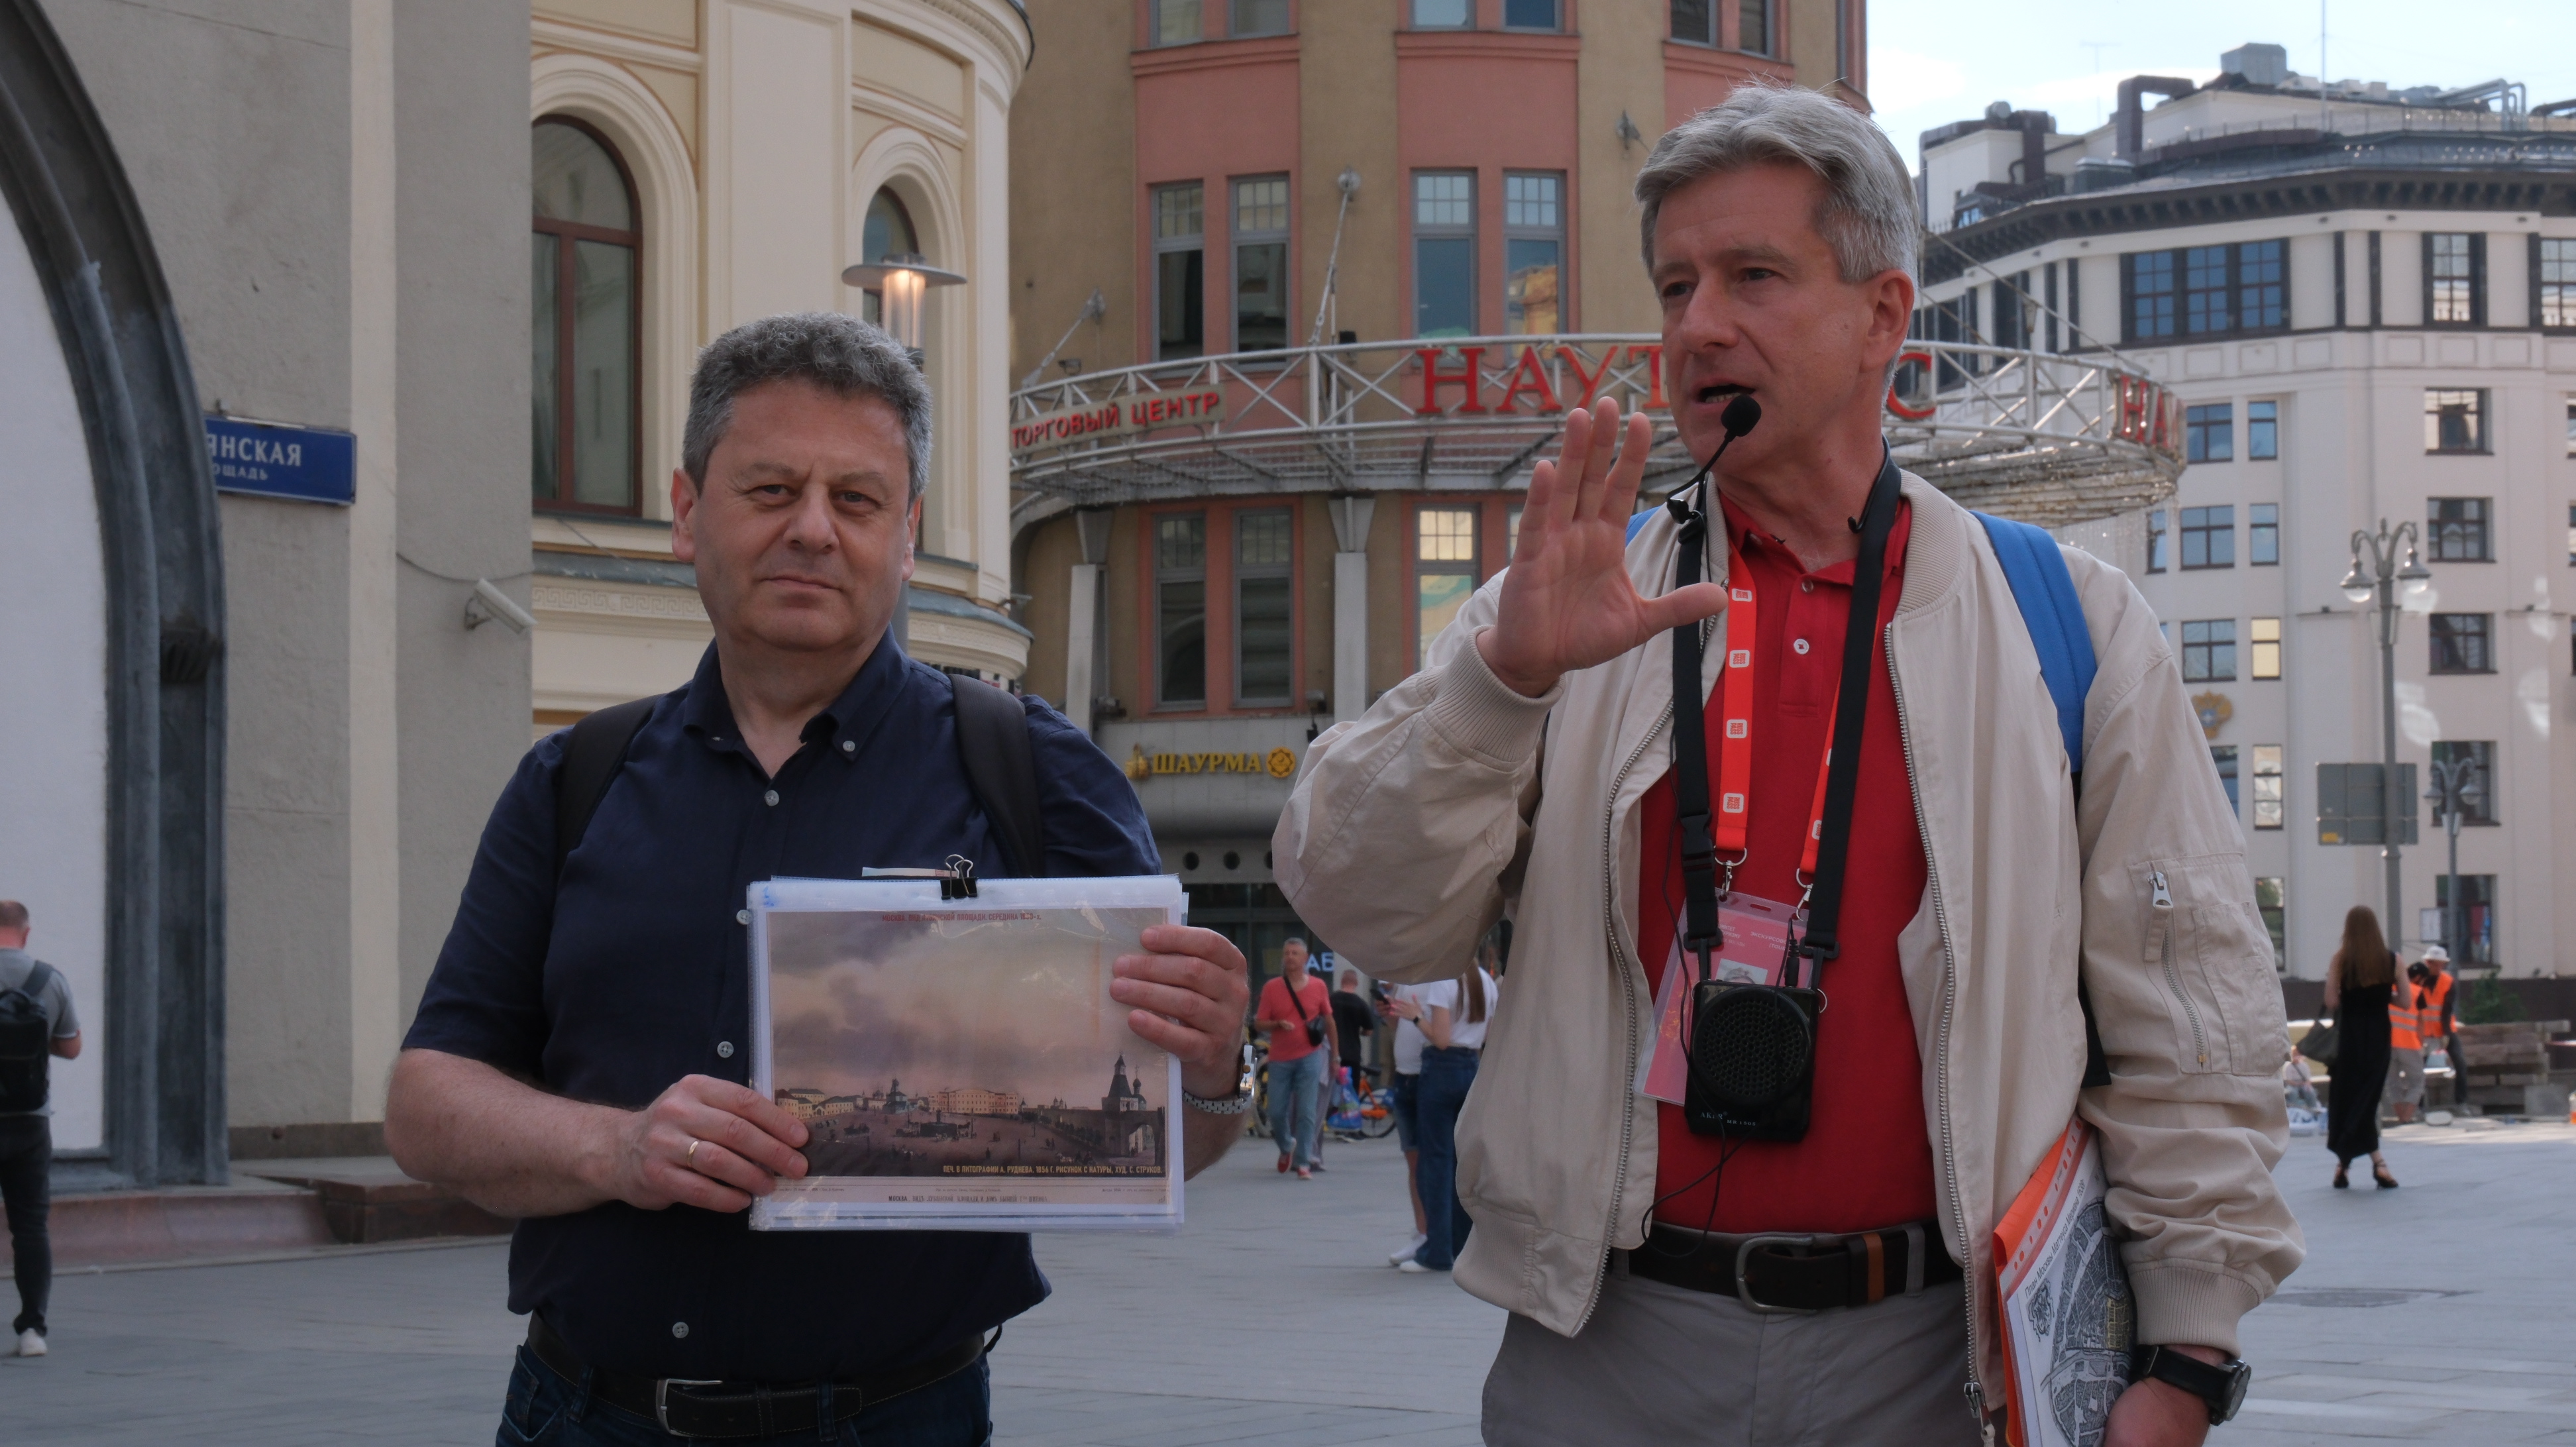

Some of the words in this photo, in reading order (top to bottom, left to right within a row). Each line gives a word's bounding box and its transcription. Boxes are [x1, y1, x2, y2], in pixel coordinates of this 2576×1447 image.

[1012, 402, 1120, 448] ТОРГОВЫЙ
[1131, 392, 1220, 427] ЦЕНТР
[1152, 753, 1262, 774] ШАУРМА
[989, 913, 1018, 922] СЕРЕДИНА
[956, 1165, 960, 1173] В
[961, 1165, 998, 1173] ЛИТОГРАФИИ
[1007, 1165, 1034, 1174] РУДНЕВА.
[2025, 1277, 2038, 1299] План
[2037, 1252, 2053, 1281] Москвы
